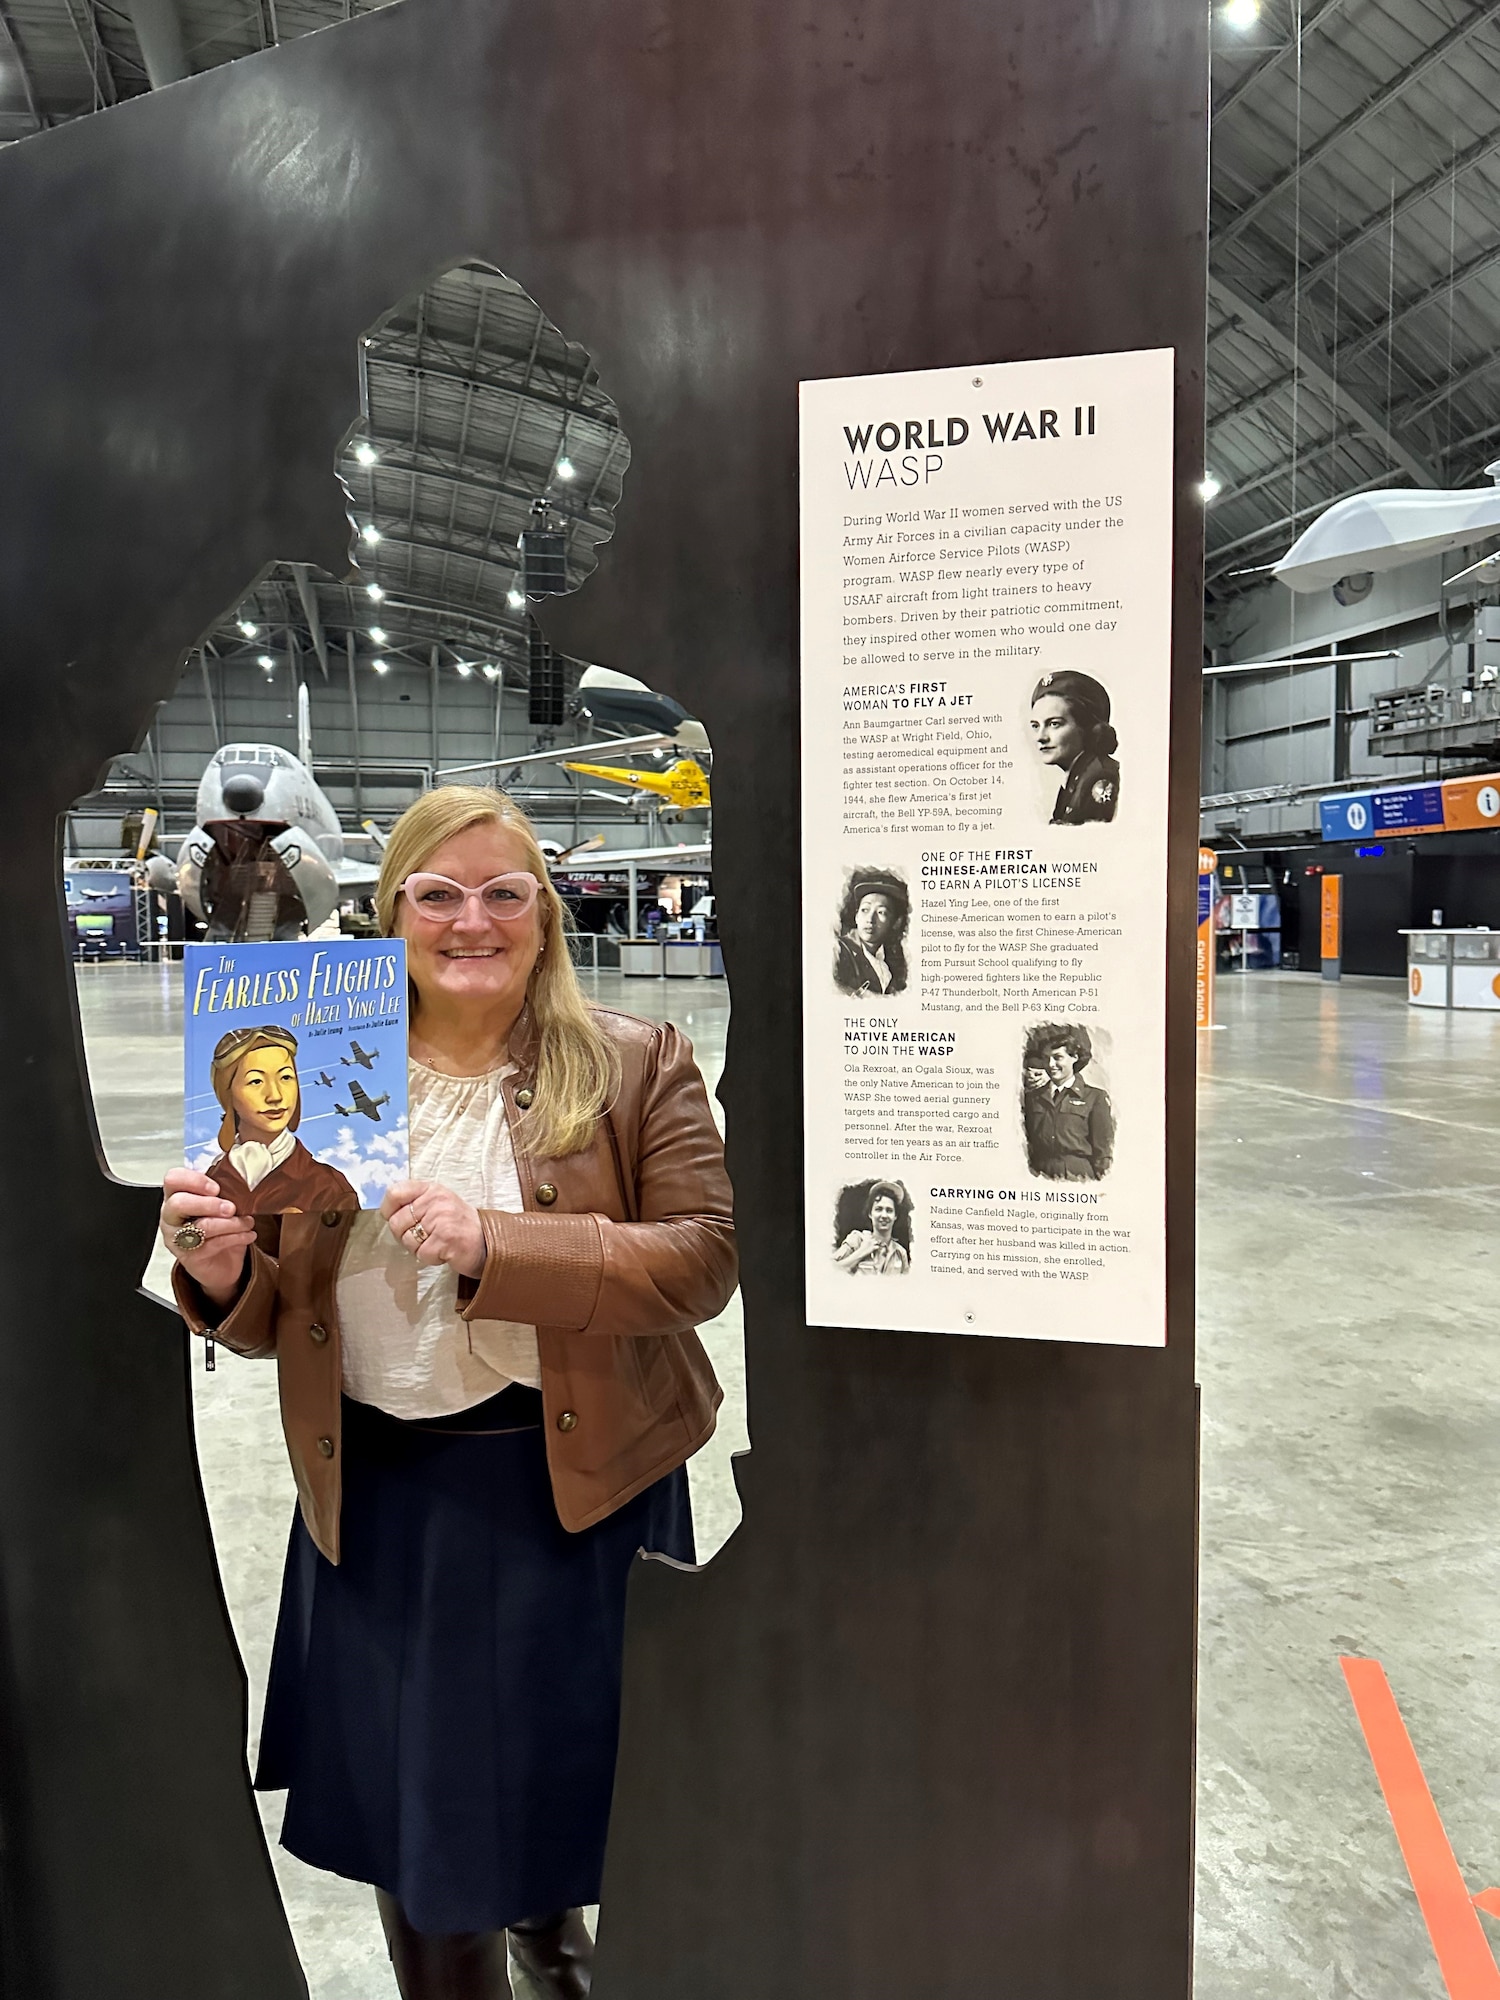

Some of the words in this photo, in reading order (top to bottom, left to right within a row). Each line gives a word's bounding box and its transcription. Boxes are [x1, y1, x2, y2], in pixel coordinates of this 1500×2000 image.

[843, 417, 970, 455] WORLD
[981, 409, 1061, 444] WAR
[1075, 405, 1096, 437] II
[843, 454, 943, 491] WASP
[843, 516, 882, 527] During
[885, 510, 920, 523] World
[923, 509, 947, 521] War
[950, 507, 959, 519] II
[962, 507, 1005, 517] women
[1008, 501, 1049, 514] served
[1053, 499, 1078, 511] with
[1082, 498, 1101, 509] the
[1105, 495, 1122, 507] US
[842, 536, 874, 547] Army
[876, 533, 893, 544] Air
[897, 532, 935, 543] Forces
[939, 529, 950, 540] in
[953, 530, 960, 539] a
[964, 526, 1007, 538] civilian
[1010, 522, 1062, 535] capacity
[1065, 518, 1101, 531] under
[1105, 517, 1124, 528] the
[843, 555, 885, 567] Women
[888, 551, 936, 564] Airforce
[939, 549, 984, 560] Service
[987, 545, 1020, 557] Pilots
[1024, 540, 1070, 555] (WASP)
[843, 575, 895, 589] program.
[899, 570, 934, 583] WASP
[938, 569, 963, 580] flew
[966, 565, 1003, 578] nearly
[1006, 565, 1040, 576] every
[1042, 563, 1069, 575] type
[1072, 559, 1085, 571] of
[843, 593, 883, 606] USAAF
[886, 591, 928, 604] aircraft
[932, 590, 959, 601] from
[962, 587, 988, 600] light
[992, 585, 1038, 597] trainers
[1041, 584, 1053, 593] to
[1057, 582, 1092, 592] heavy
[843, 614, 896, 626] bombers.
[901, 612, 939, 623] Driven
[942, 609, 957, 622] by
[960, 608, 987, 619] their
[990, 605, 1041, 619] patriotic
[1044, 599, 1123, 613] commitment,
[843, 635, 867, 647] they
[870, 631, 918, 645] inspired
[921, 630, 951, 641] other
[954, 629, 997, 639] women
[1000, 625, 1025, 636] who
[1028, 622, 1065, 634] would
[1068, 623, 1091, 632] one
[1094, 620, 1118, 632] day
[843, 655, 857, 665] be
[861, 652, 905, 665] allowed
[909, 653, 920, 662] to
[923, 651, 955, 661] serve
[958, 650, 969, 659] in
[973, 647, 992, 658] the
[995, 645, 1042, 657] military.
[843, 683, 906, 697] AMERICA'S
[910, 681, 947, 694] FIRST
[843, 699, 888, 711] WOMAN
[892, 698, 910, 709] TO
[914, 697, 935, 708] FLY
[938, 696, 947, 707] A
[950, 695, 974, 706] JET
[842, 721, 861, 730] Ann
[863, 719, 923, 729] Baumgartner
[925, 716, 946, 726] Carl
[948, 715, 981, 725] served
[982, 714, 1003, 723] with
[843, 825, 889, 834] America's
[891, 824, 909, 833] first
[958, 822, 970, 832] fly
[980, 823, 995, 832] jet.
[921, 851, 946, 863] ONE
[949, 851, 965, 862] OF
[968, 850, 991, 861] THE
[995, 849, 1033, 861] FIRST
[567, 872, 607, 882] VIRTUAL
[921, 863, 1047, 876] CHINESE-AMERICAN
[1051, 862, 1098, 874] WOMEN
[921, 880, 937, 891] TO
[940, 879, 970, 890] EARN
[973, 879, 982, 890] A
[985, 878, 1029, 890] PILOT'S
[1033, 877, 1081, 889] LICENSE
[921, 899, 947, 908] Hazel
[948, 899, 969, 909] Ying
[971, 898, 991, 908] Lee,
[1013, 898, 1023, 907] of
[1024, 898, 1039, 906] the
[1041, 897, 1060, 906] first
[921, 944, 941, 954] pilot
[954, 943, 966, 954] fly
[967, 943, 980, 952] for
[982, 944, 997, 952] the
[998, 943, 1028, 952] WASP.
[1030, 943, 1048, 952] She
[1050, 942, 1099, 953] graduated
[193, 967, 301, 1016] FEARLESS
[307, 951, 397, 999] FLIGHTS
[304, 1001, 341, 1026] HAZEL
[347, 998, 376, 1019] YING
[379, 991, 402, 1014] LEE
[844, 1018, 866, 1028] THE
[869, 1018, 898, 1028] ONLY
[844, 1031, 888, 1042] NATIVE
[891, 1032, 956, 1043] AMERICAN
[843, 1045, 859, 1055] TO
[862, 1045, 889, 1056] JOIN
[892, 1045, 915, 1056] THE
[918, 1046, 954, 1057] WASP
[844, 1064, 860, 1073] Ola
[863, 1064, 899, 1074] Rexroat,
[915, 1065, 944, 1075] Ogala
[945, 1065, 974, 1075] Sioux,
[930, 1187, 994, 1200] CARRYING
[998, 1190, 1016, 1201] ON
[1021, 1191, 1041, 1202] HIS
[1045, 1192, 1098, 1204] MISSION
[930, 1206, 963, 1216] Nadine
[965, 1207, 1005, 1217] Canfield
[1007, 1209, 1038, 1220] Nagle,
[1040, 1212, 1085, 1222] originally
[1087, 1212, 1109, 1222] from
